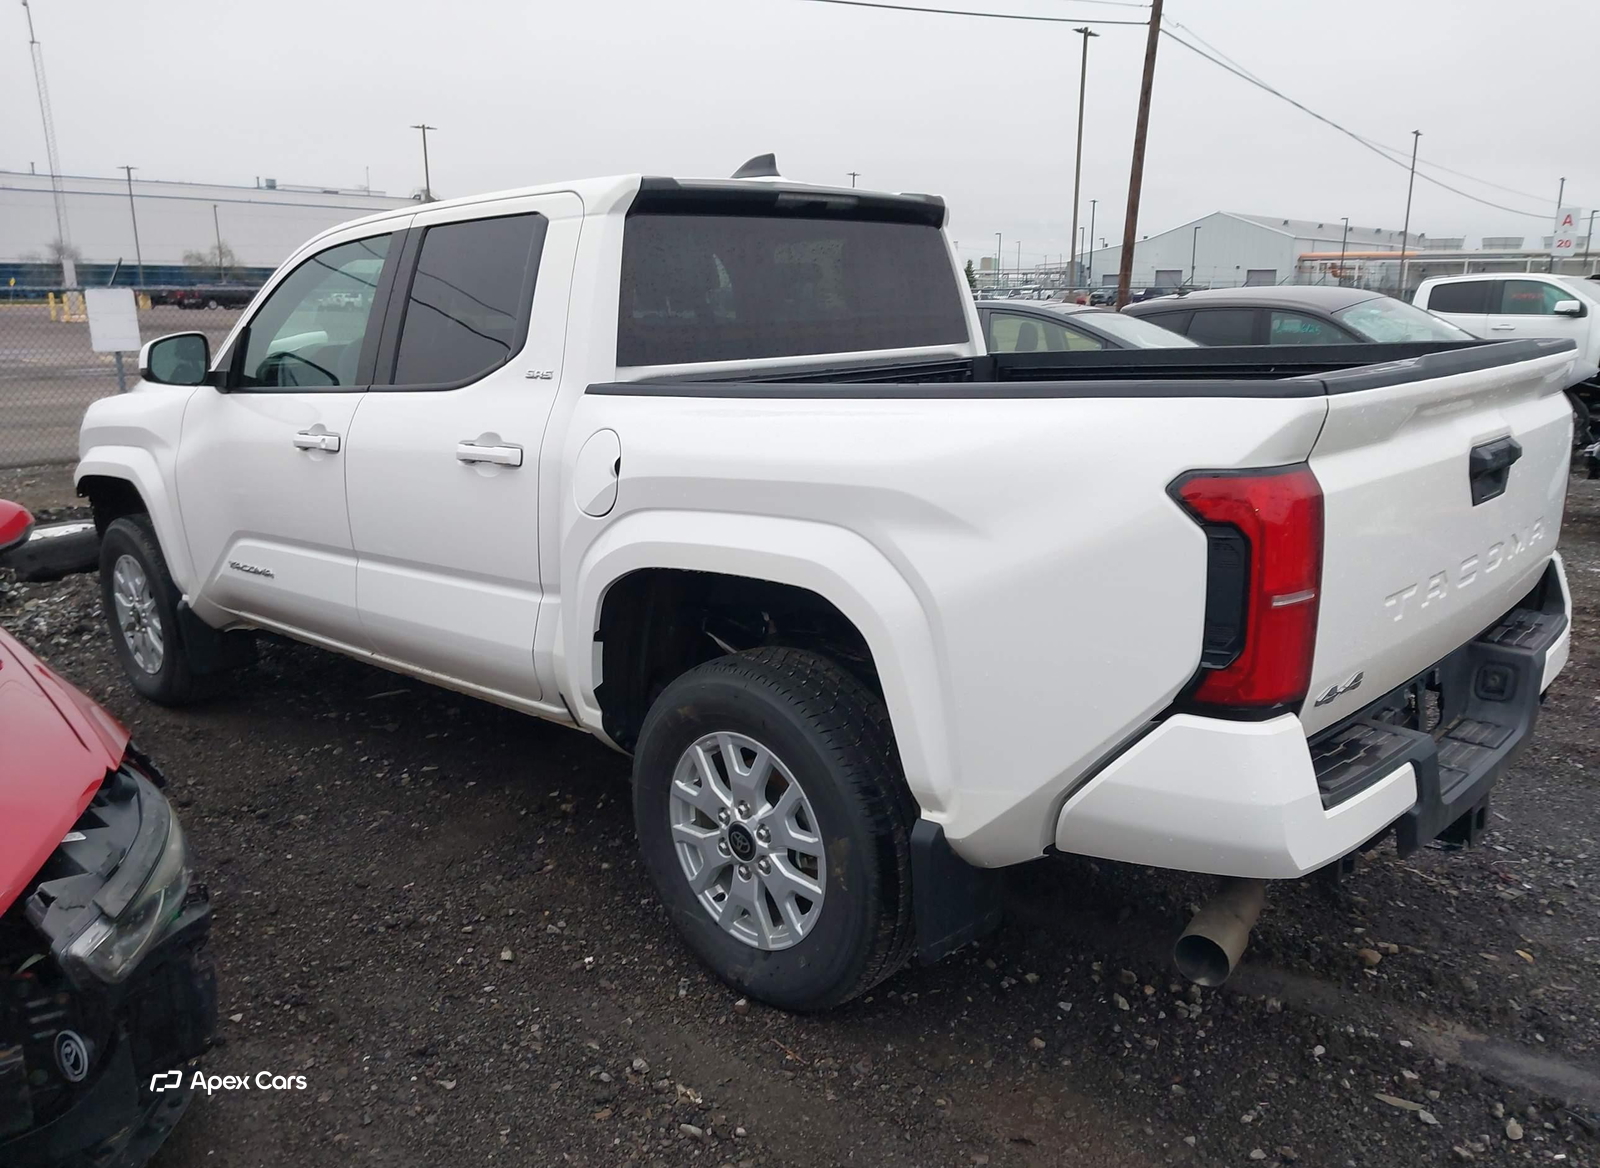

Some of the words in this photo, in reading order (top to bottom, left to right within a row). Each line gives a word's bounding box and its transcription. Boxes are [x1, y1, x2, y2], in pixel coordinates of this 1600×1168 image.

[1562, 213, 1573, 227] A
[1556, 239, 1572, 248] 20
[228, 560, 275, 580] TACOMA
[1384, 516, 1545, 622] TACOMA
